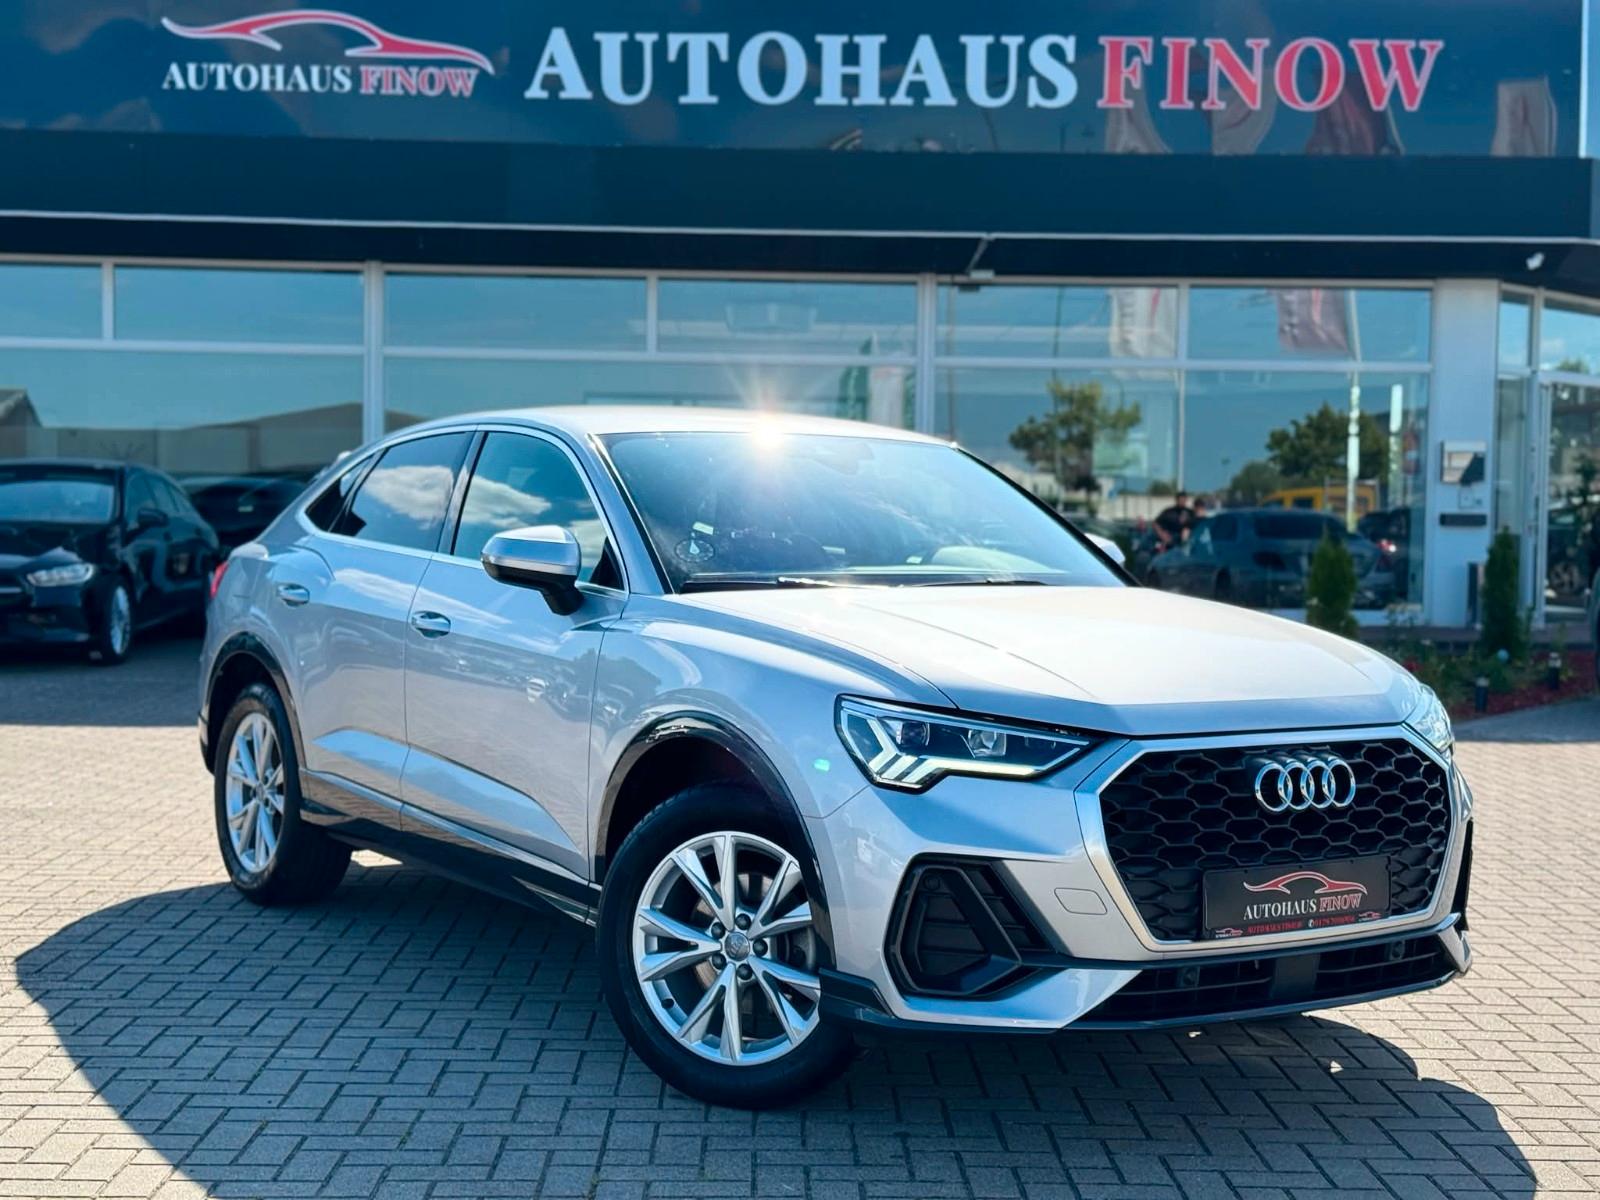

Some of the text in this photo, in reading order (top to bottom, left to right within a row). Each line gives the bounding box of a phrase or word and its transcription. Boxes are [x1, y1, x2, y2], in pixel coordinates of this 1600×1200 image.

[162, 62, 479, 97] AUTOHAUS FINOW
[523, 27, 1443, 112] AUTOHAUS FINOW
[1243, 893, 1362, 920] AUTOHAUS FINOW
